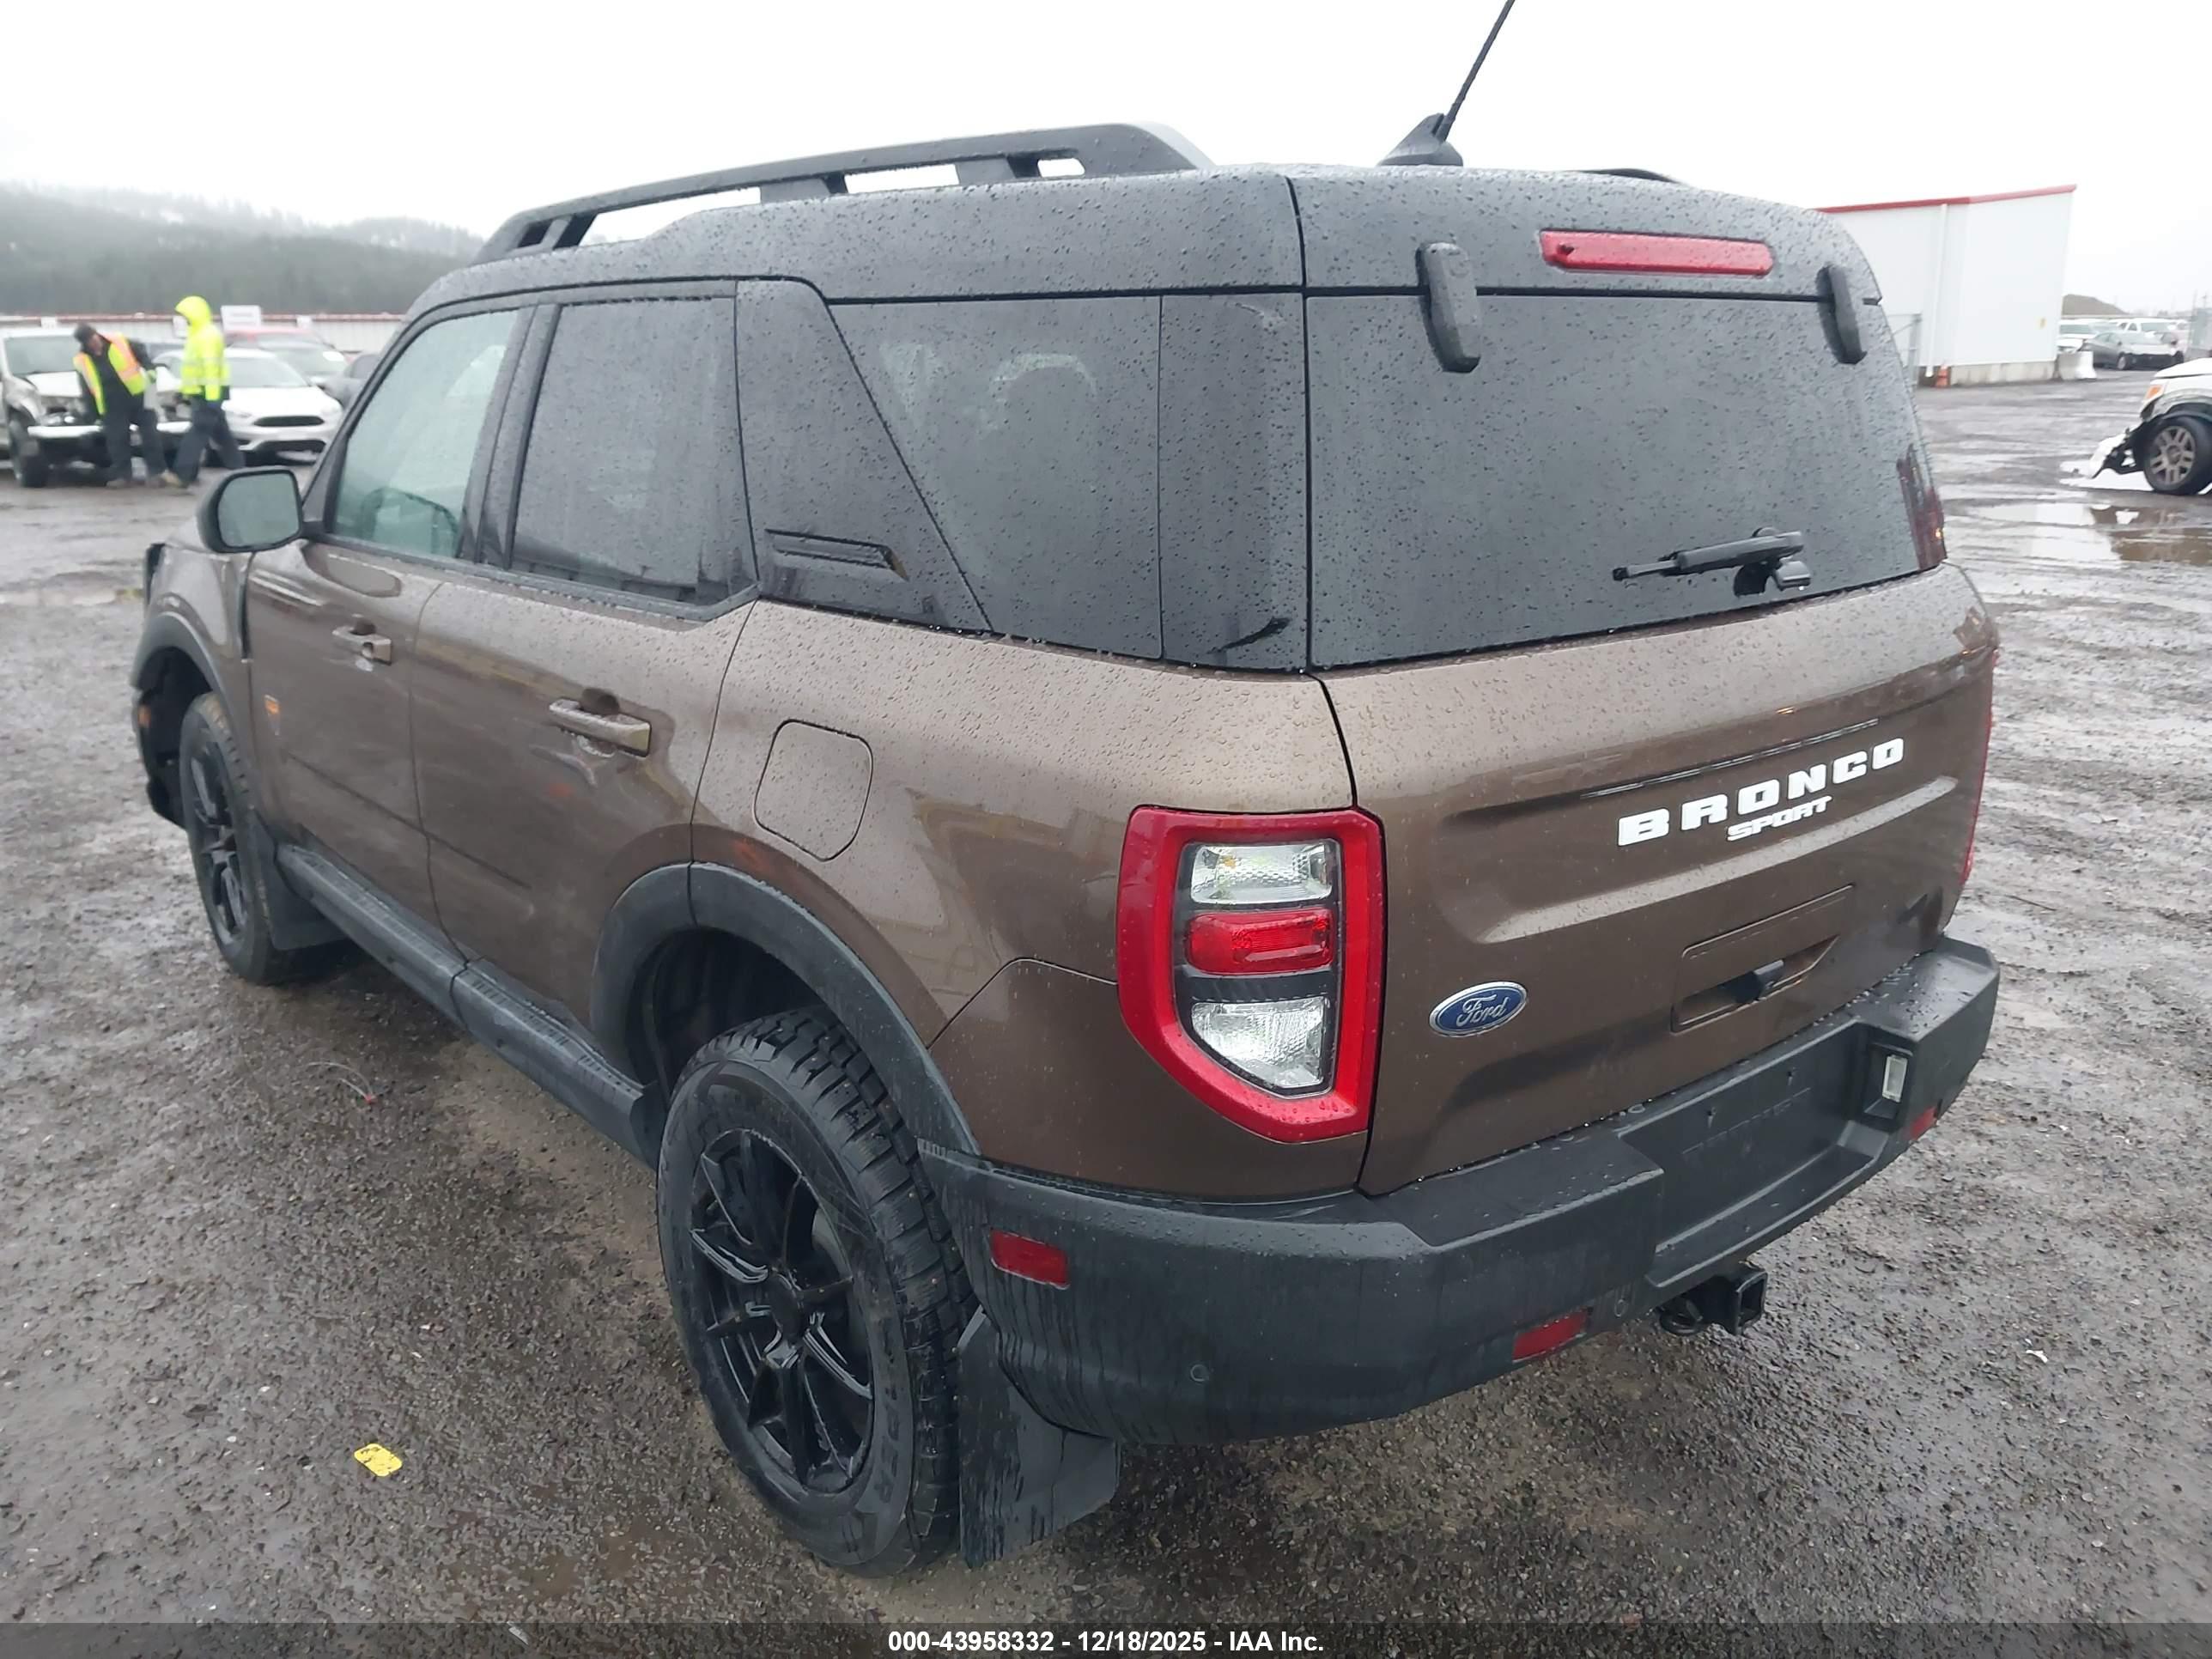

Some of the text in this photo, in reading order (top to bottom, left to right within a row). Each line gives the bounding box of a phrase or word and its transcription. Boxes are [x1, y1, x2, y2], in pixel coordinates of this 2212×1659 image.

[1618, 738, 1905, 847] BRONCO
[1726, 795, 1832, 842] SPORT
[1455, 994, 1510, 1027] Ford
